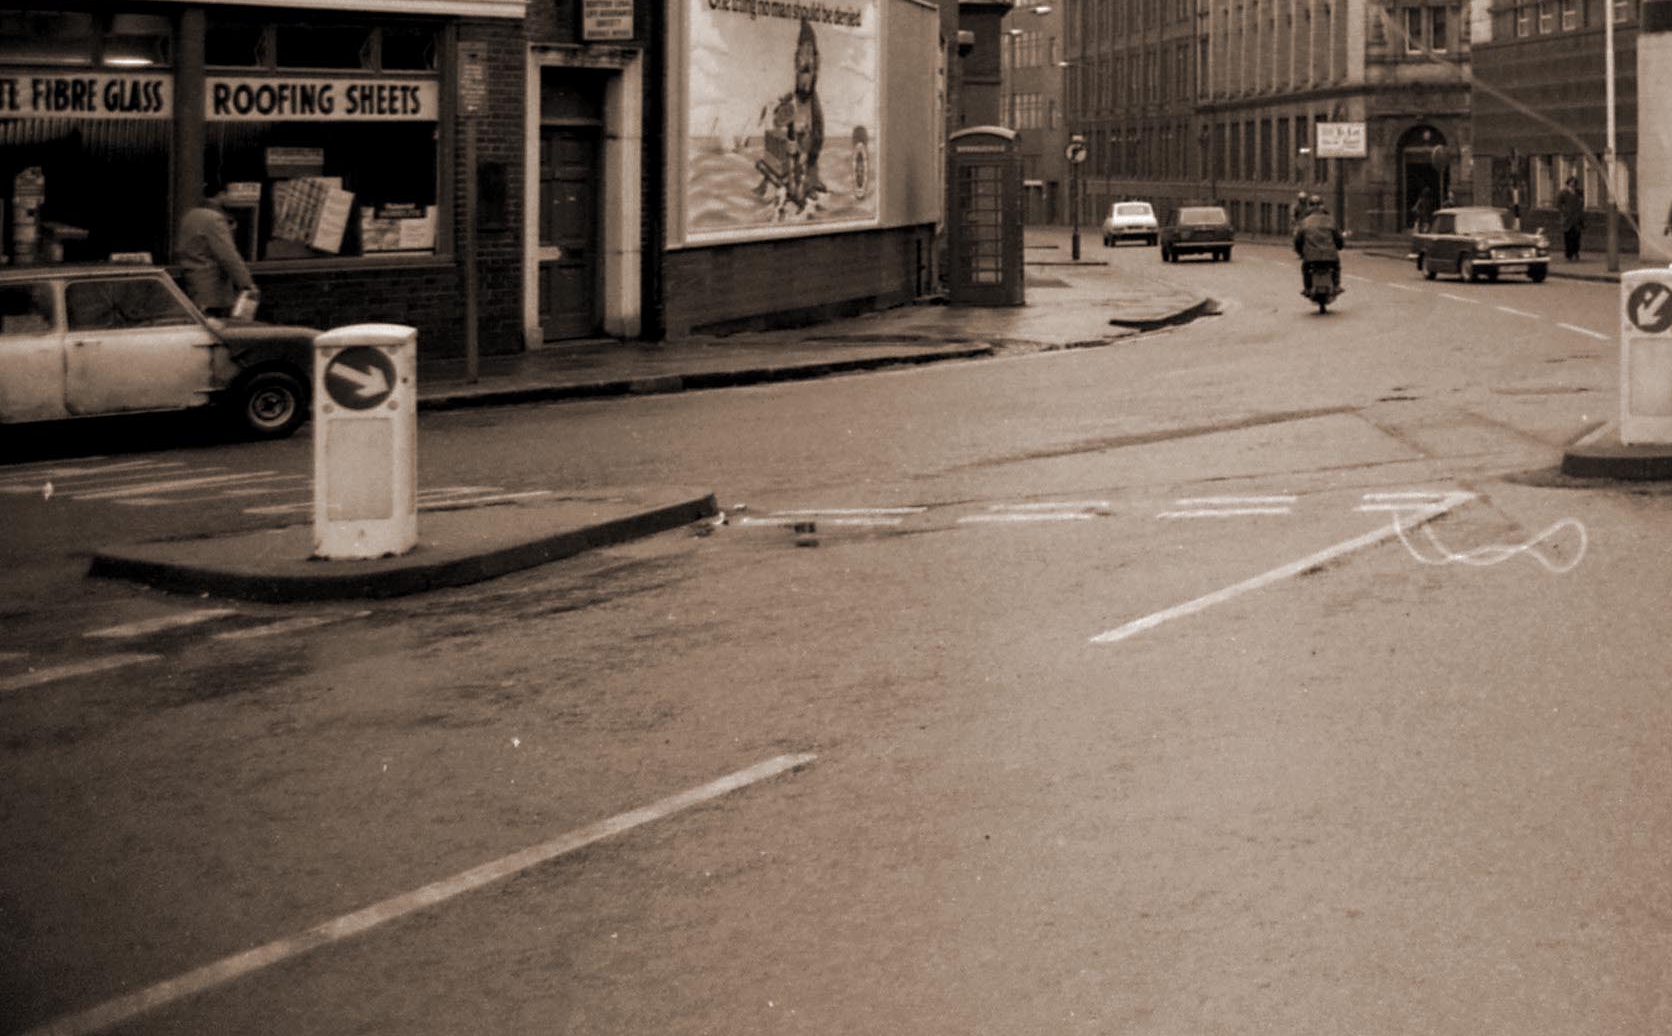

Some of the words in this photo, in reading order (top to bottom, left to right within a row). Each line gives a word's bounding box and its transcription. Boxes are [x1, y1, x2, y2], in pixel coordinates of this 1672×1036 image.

[758, 0, 770, 16] no
[771, 1, 792, 19] man
[793, 0, 821, 23] should
[822, 5, 833, 24] be
[833, 6, 862, 28] denied
[32, 79, 98, 113] FIBRE
[103, 80, 163, 114] GLASS
[213, 82, 334, 115] ROOFING
[345, 84, 421, 115] SHEETS
